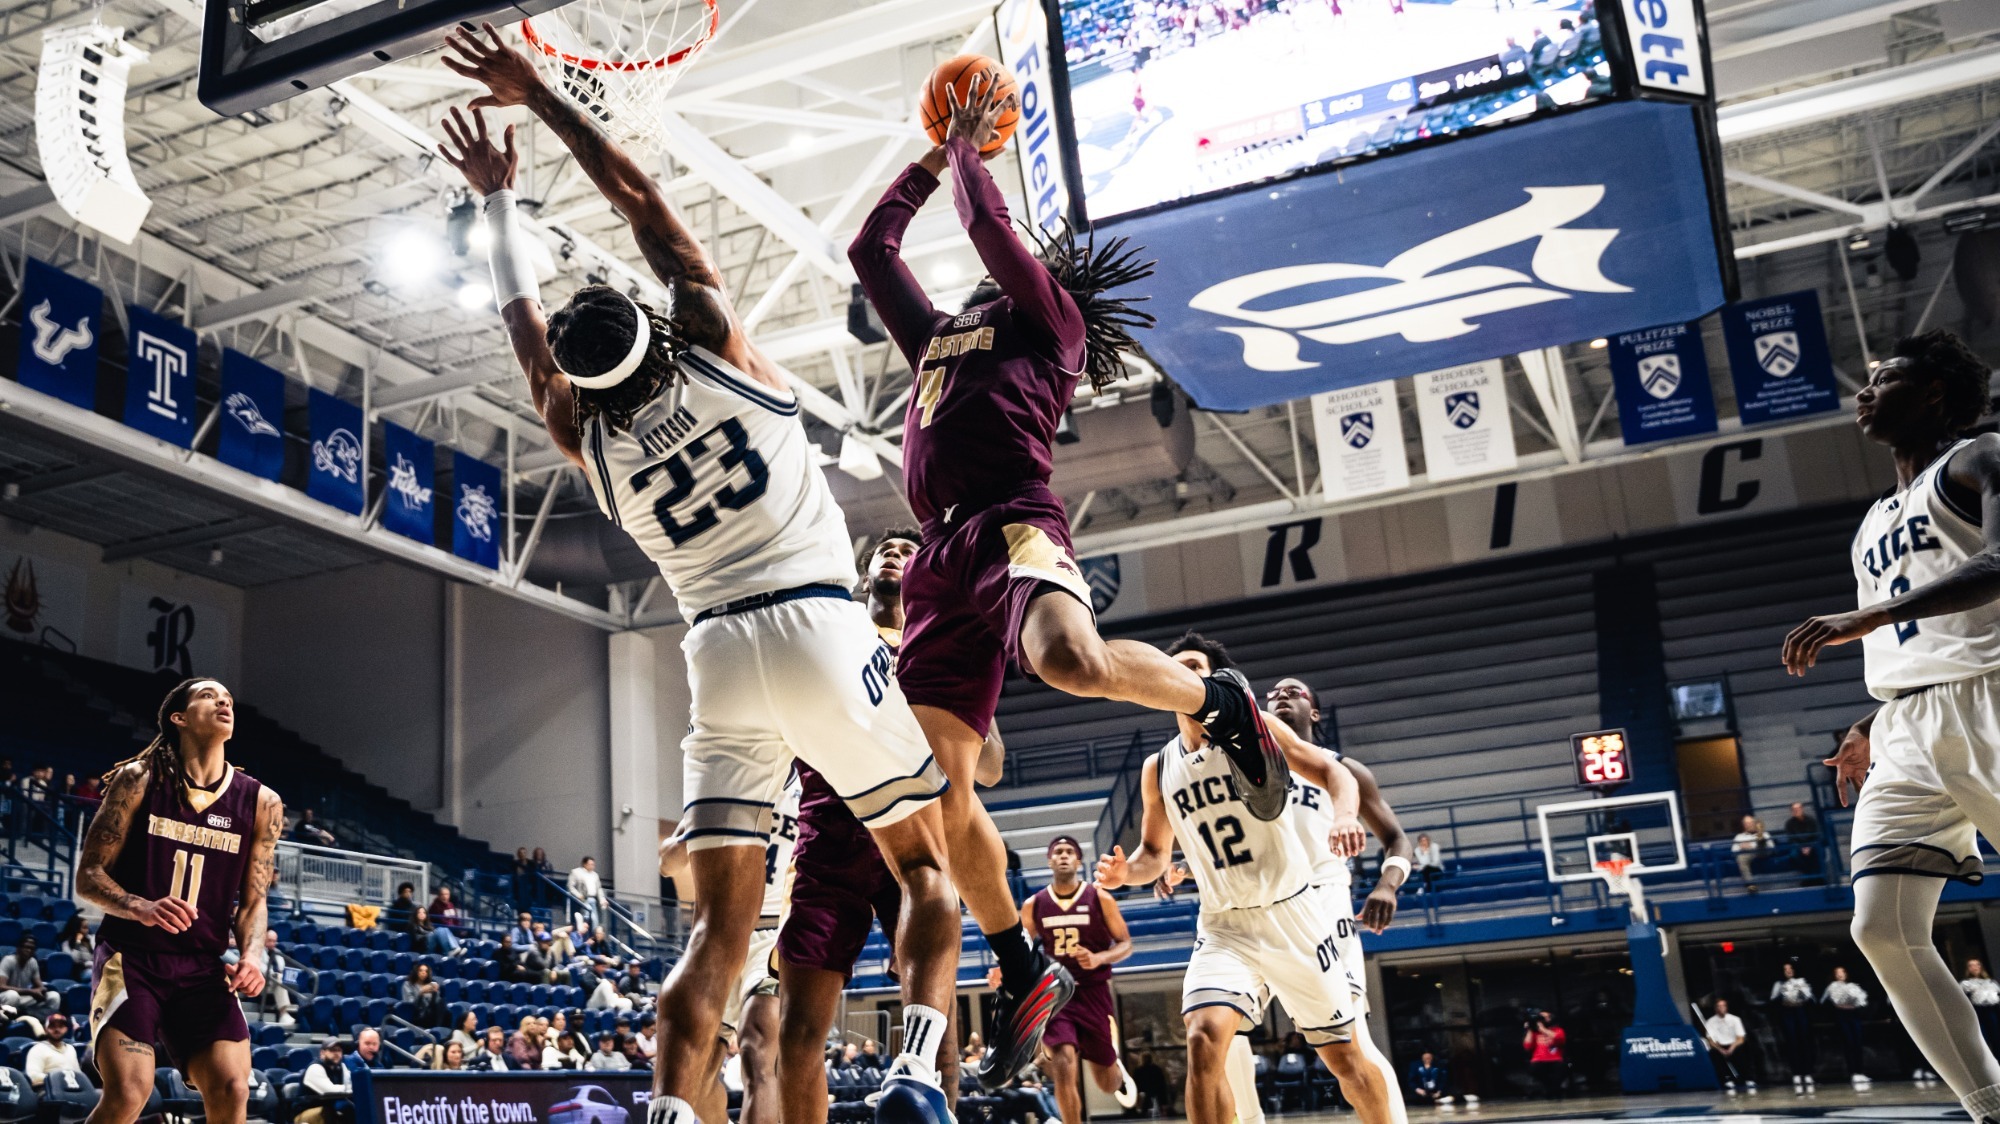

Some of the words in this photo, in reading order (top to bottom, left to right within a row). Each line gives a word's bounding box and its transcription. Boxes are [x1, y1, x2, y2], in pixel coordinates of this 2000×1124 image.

[1006, 42, 1061, 242] Follett
[1745, 303, 1795, 321] NOBEL
[1751, 316, 1794, 333] PRIZE
[940, 327, 995, 359] STATE
[1619, 324, 1687, 346] PULITZER
[1635, 339, 1676, 355] PRIZE
[1429, 376, 1490, 395] SCHOLAR
[1431, 366, 1485, 383] RHODES
[917, 366, 946, 430] 4
[1325, 396, 1383, 416] SCHOLAR
[1328, 386, 1379, 405] RHODES
[629, 415, 771, 549] 23
[1584, 750, 1624, 782] 26
[148, 813, 197, 844] TEXAS
[193, 826, 242, 855] STATE
[1197, 814, 1254, 869] 12
[169, 848, 206, 910] 11
[1053, 927, 1080, 957] 22
[383, 1096, 458, 1124] Electrify
[460, 1096, 490, 1124] the
[491, 1099, 538, 1124] town.
